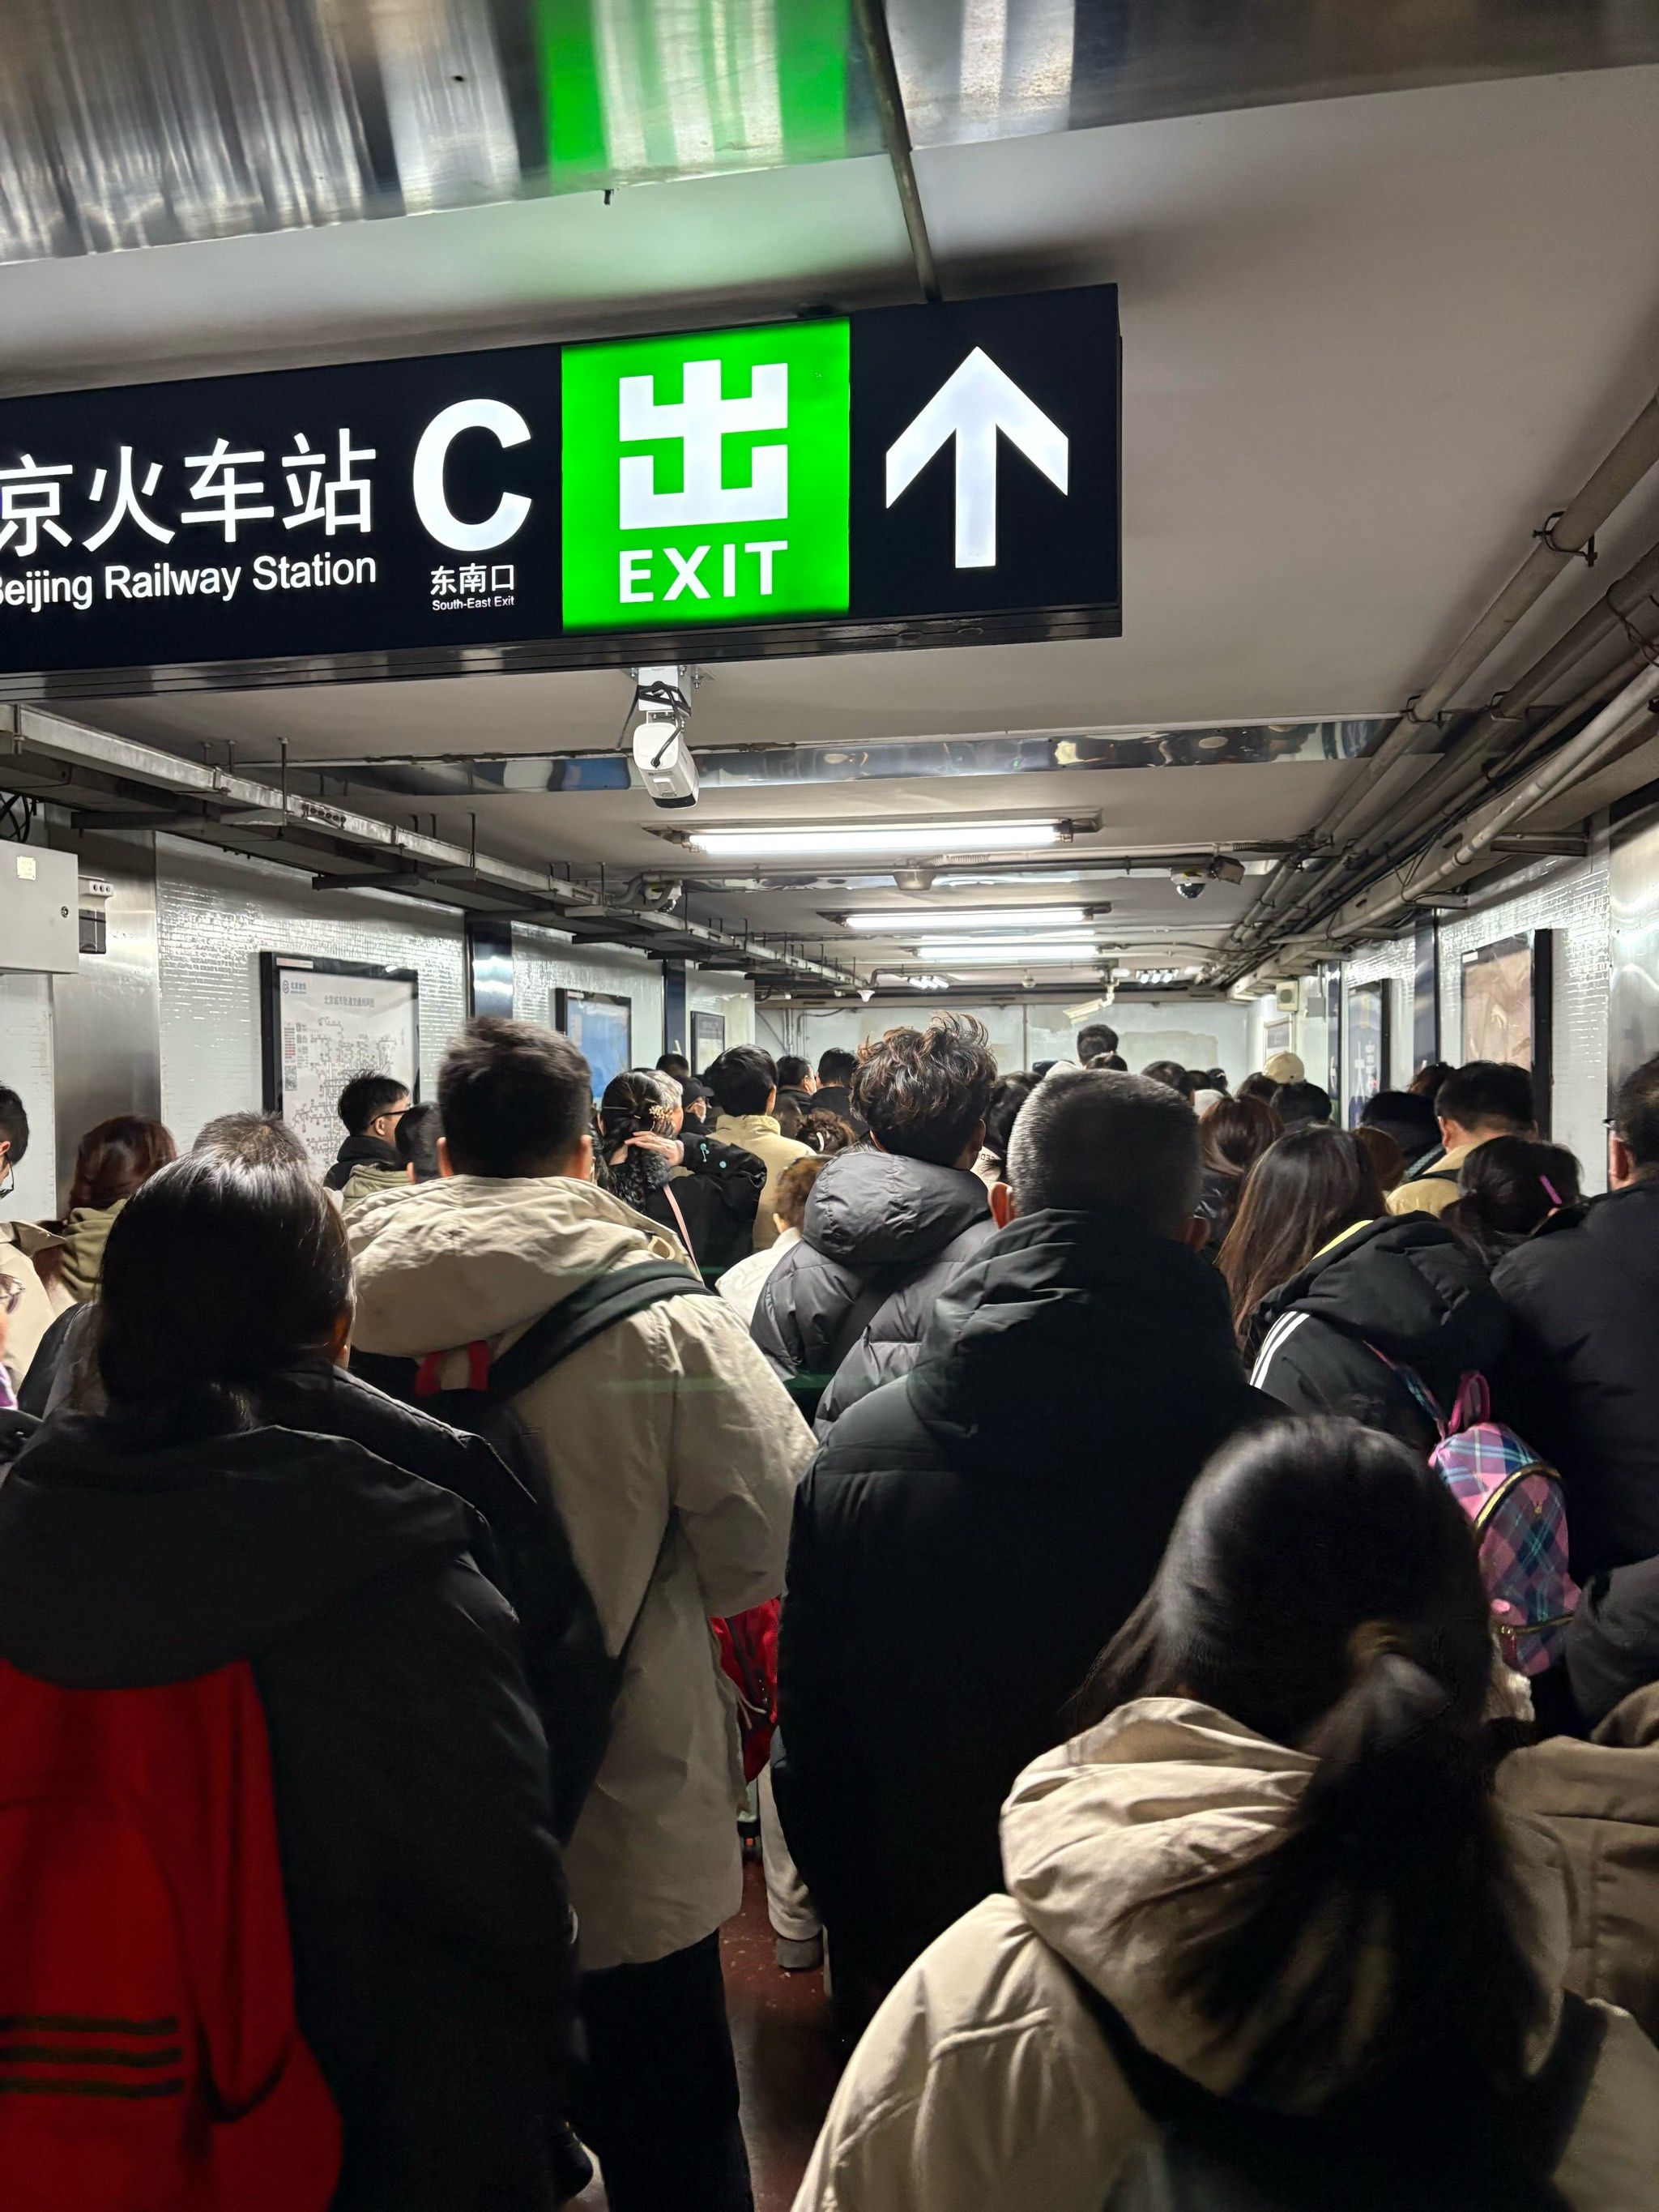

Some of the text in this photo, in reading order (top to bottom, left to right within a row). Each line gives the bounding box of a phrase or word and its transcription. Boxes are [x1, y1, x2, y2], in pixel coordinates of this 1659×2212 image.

[413, 399, 531, 552] C
[620, 359, 788, 530] 出
[0, 428, 376, 557] 京火车站
[0, 551, 377, 613] eijing Railway Station
[430, 562, 514, 596] 东南口
[620, 540, 788, 603] EXIT
[432, 596, 514, 611] South-East Exit
